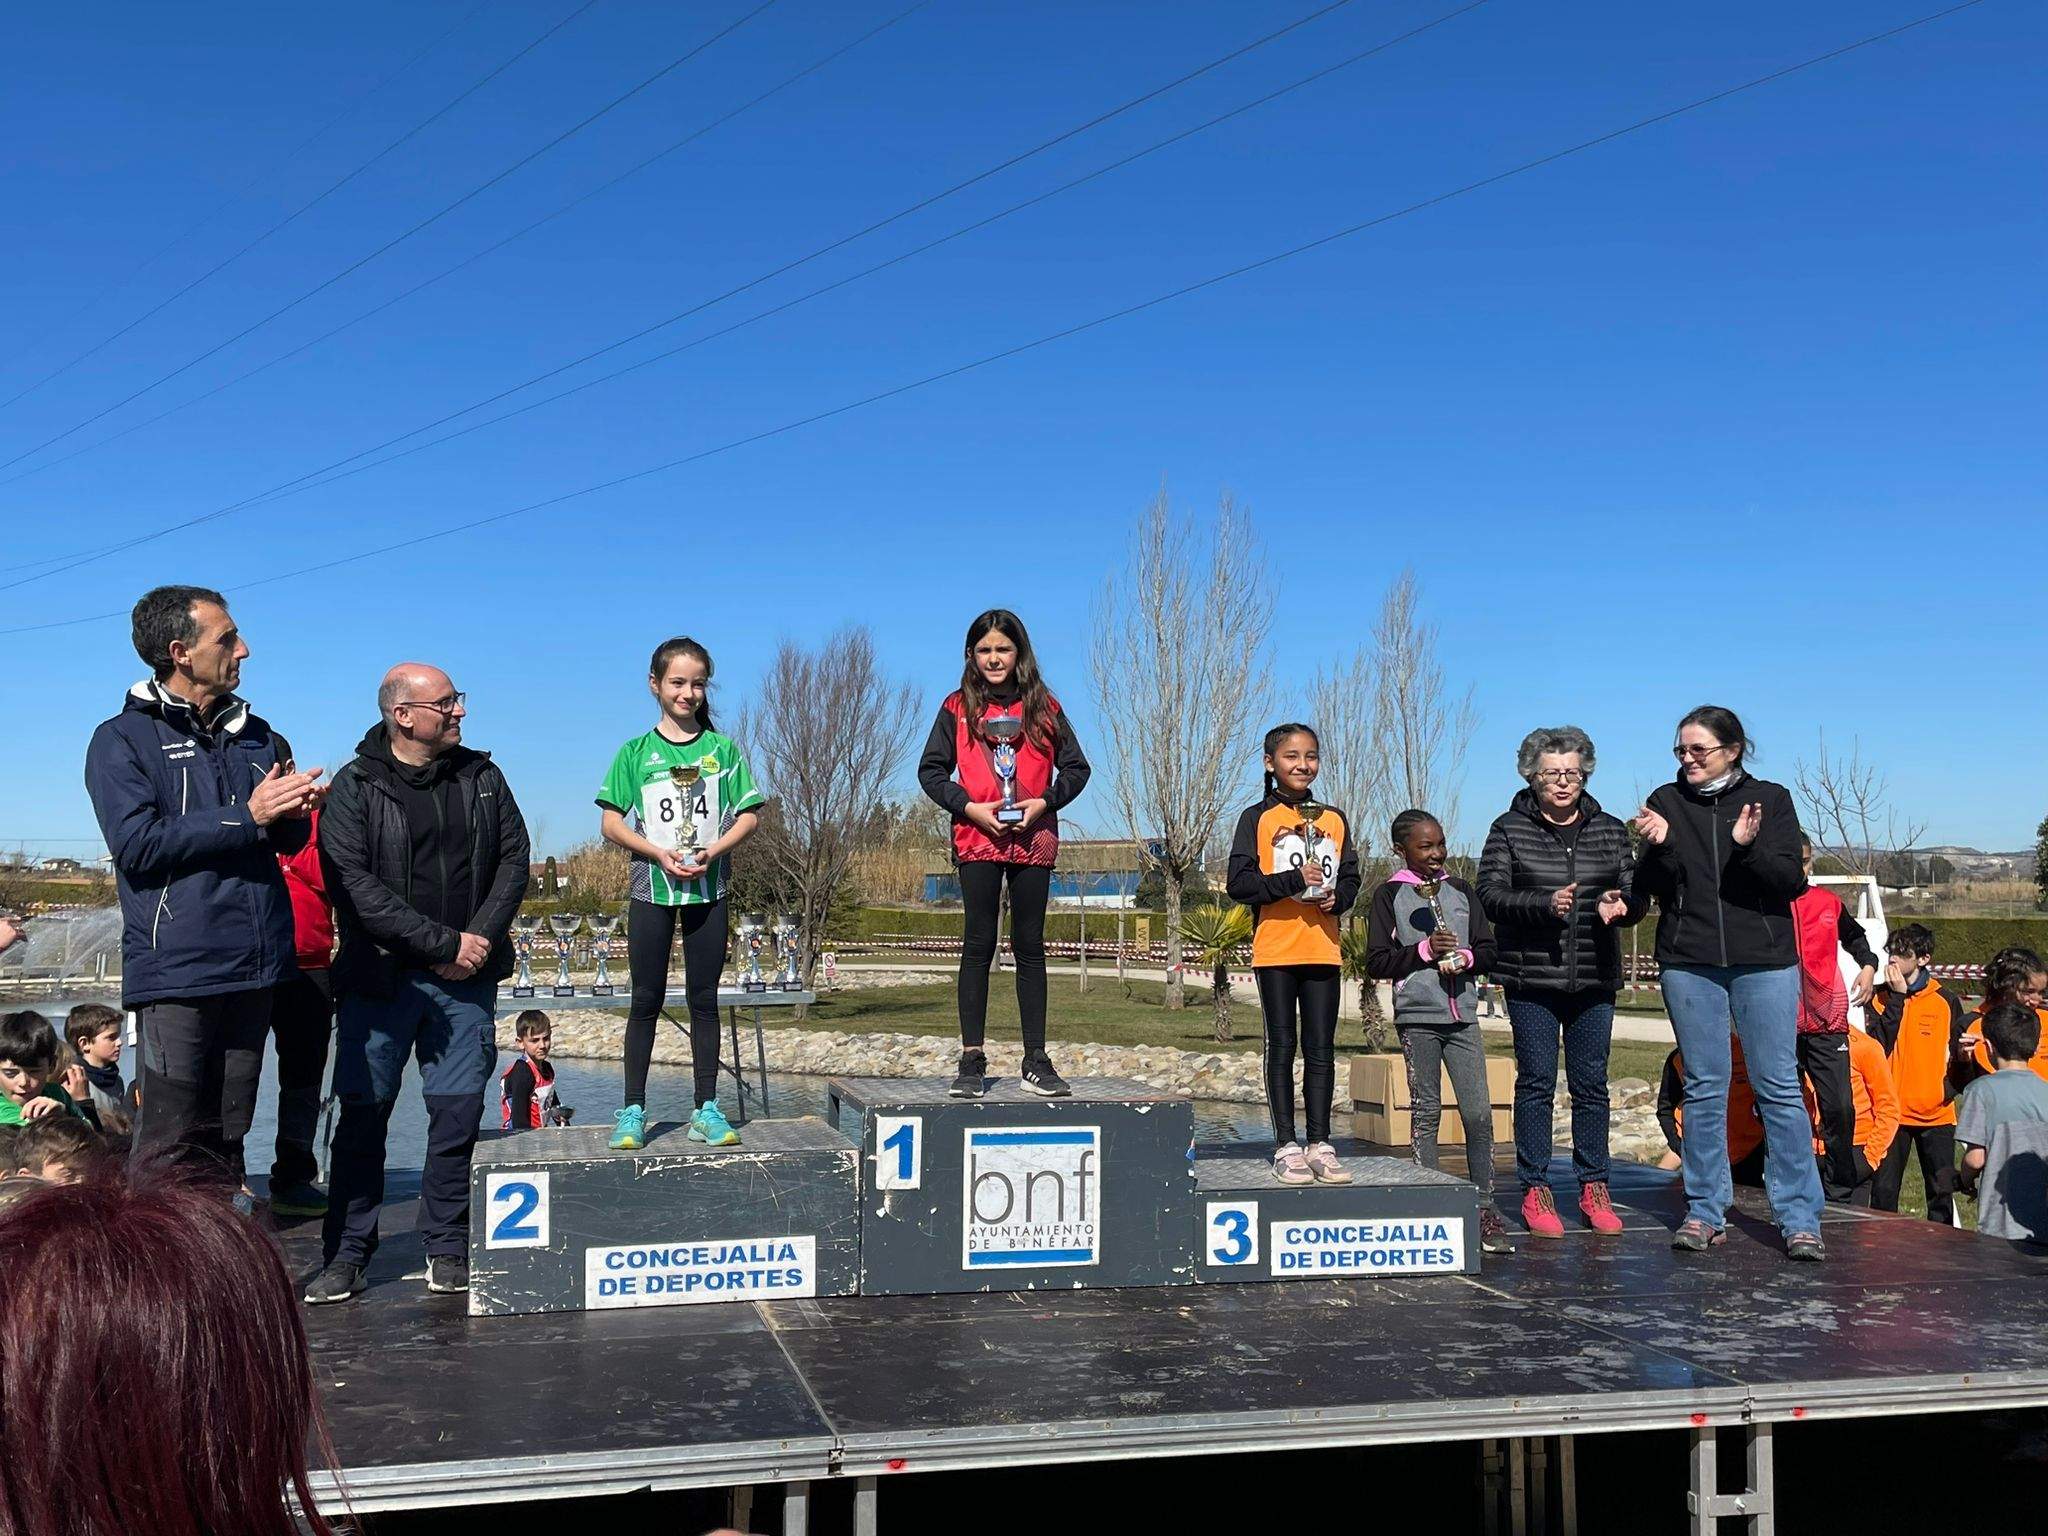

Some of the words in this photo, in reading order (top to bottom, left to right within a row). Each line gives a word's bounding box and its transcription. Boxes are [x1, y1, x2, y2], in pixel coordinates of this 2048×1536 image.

[659, 795, 709, 823] 84
[883, 1125, 914, 1179] 1
[970, 1150, 1095, 1225] bnf
[492, 1182, 540, 1241] 2
[969, 1224, 1094, 1237] AYUNTAMIENTO
[969, 1238, 990, 1250] DE
[1213, 1210, 1253, 1264] 3
[1285, 1224, 1449, 1244] CONCEJALIA
[605, 1243, 798, 1270] CONCEJALIA
[1280, 1251, 1312, 1269] DE
[1320, 1248, 1454, 1268] DEPORTES
[598, 1277, 637, 1297] DE
[645, 1268, 804, 1294] DEPORTES
